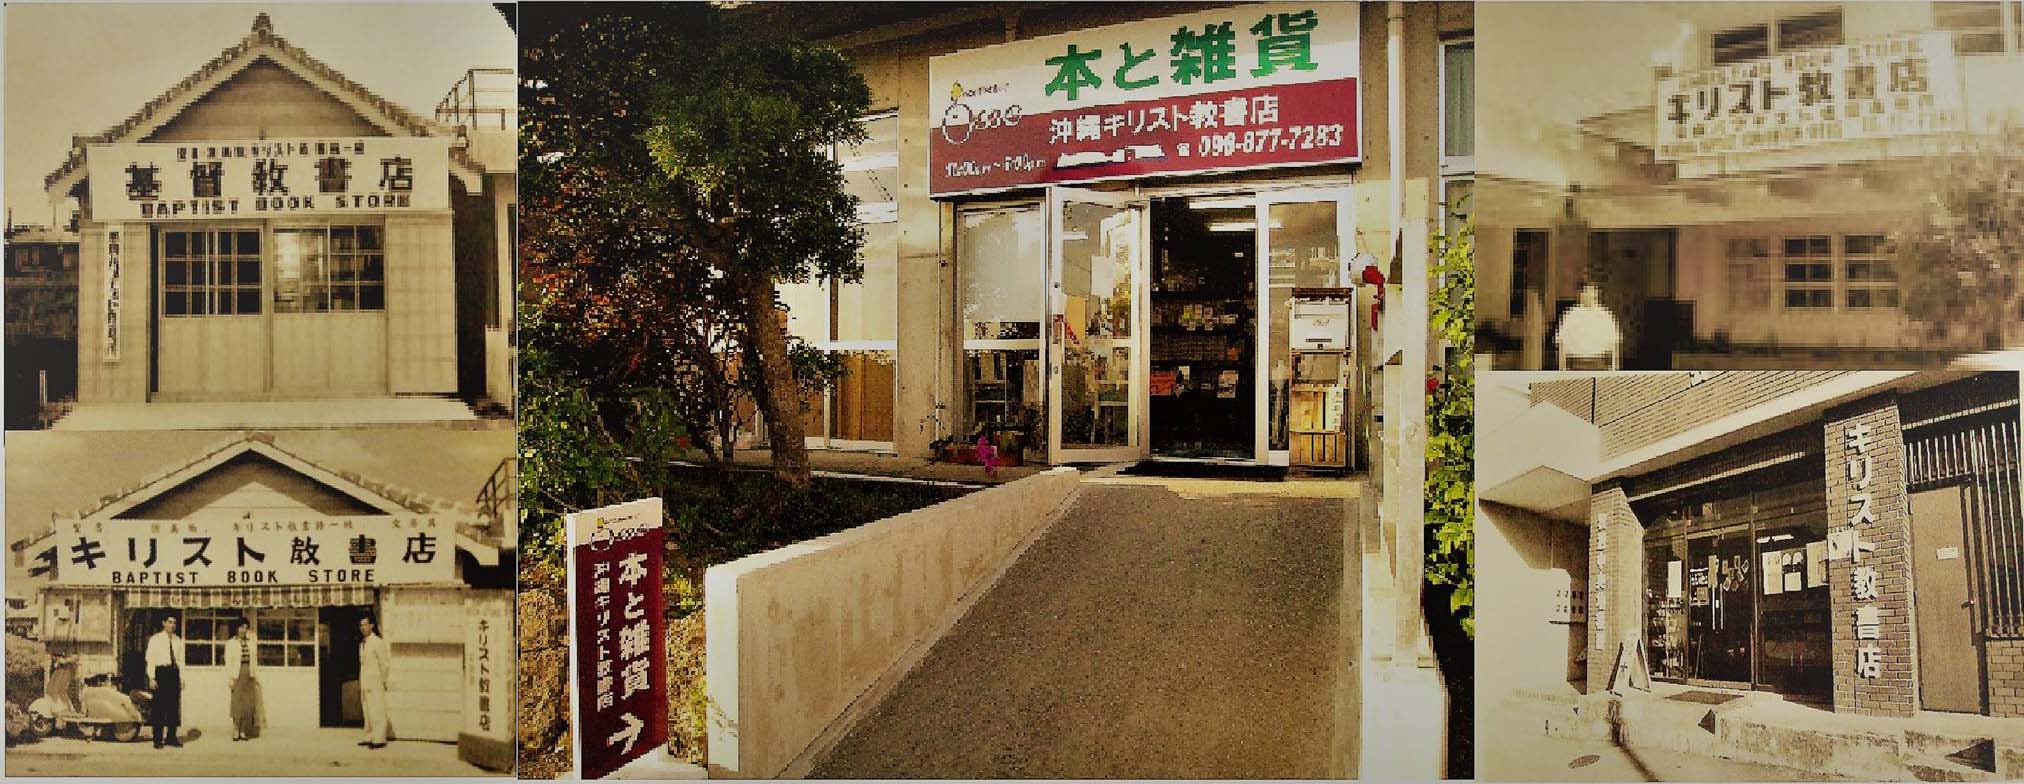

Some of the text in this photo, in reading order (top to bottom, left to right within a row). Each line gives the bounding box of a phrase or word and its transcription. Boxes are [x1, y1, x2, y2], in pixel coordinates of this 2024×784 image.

[1045, 10, 1319, 101] 本と雑貨
[140, 194, 411, 218] BAPTIST BOOK STORE
[112, 569, 375, 584] BAPTIST BOOK STORE
[1846, 422, 1881, 679] キリスト教書店
[618, 552, 650, 700] 本と雑貨
